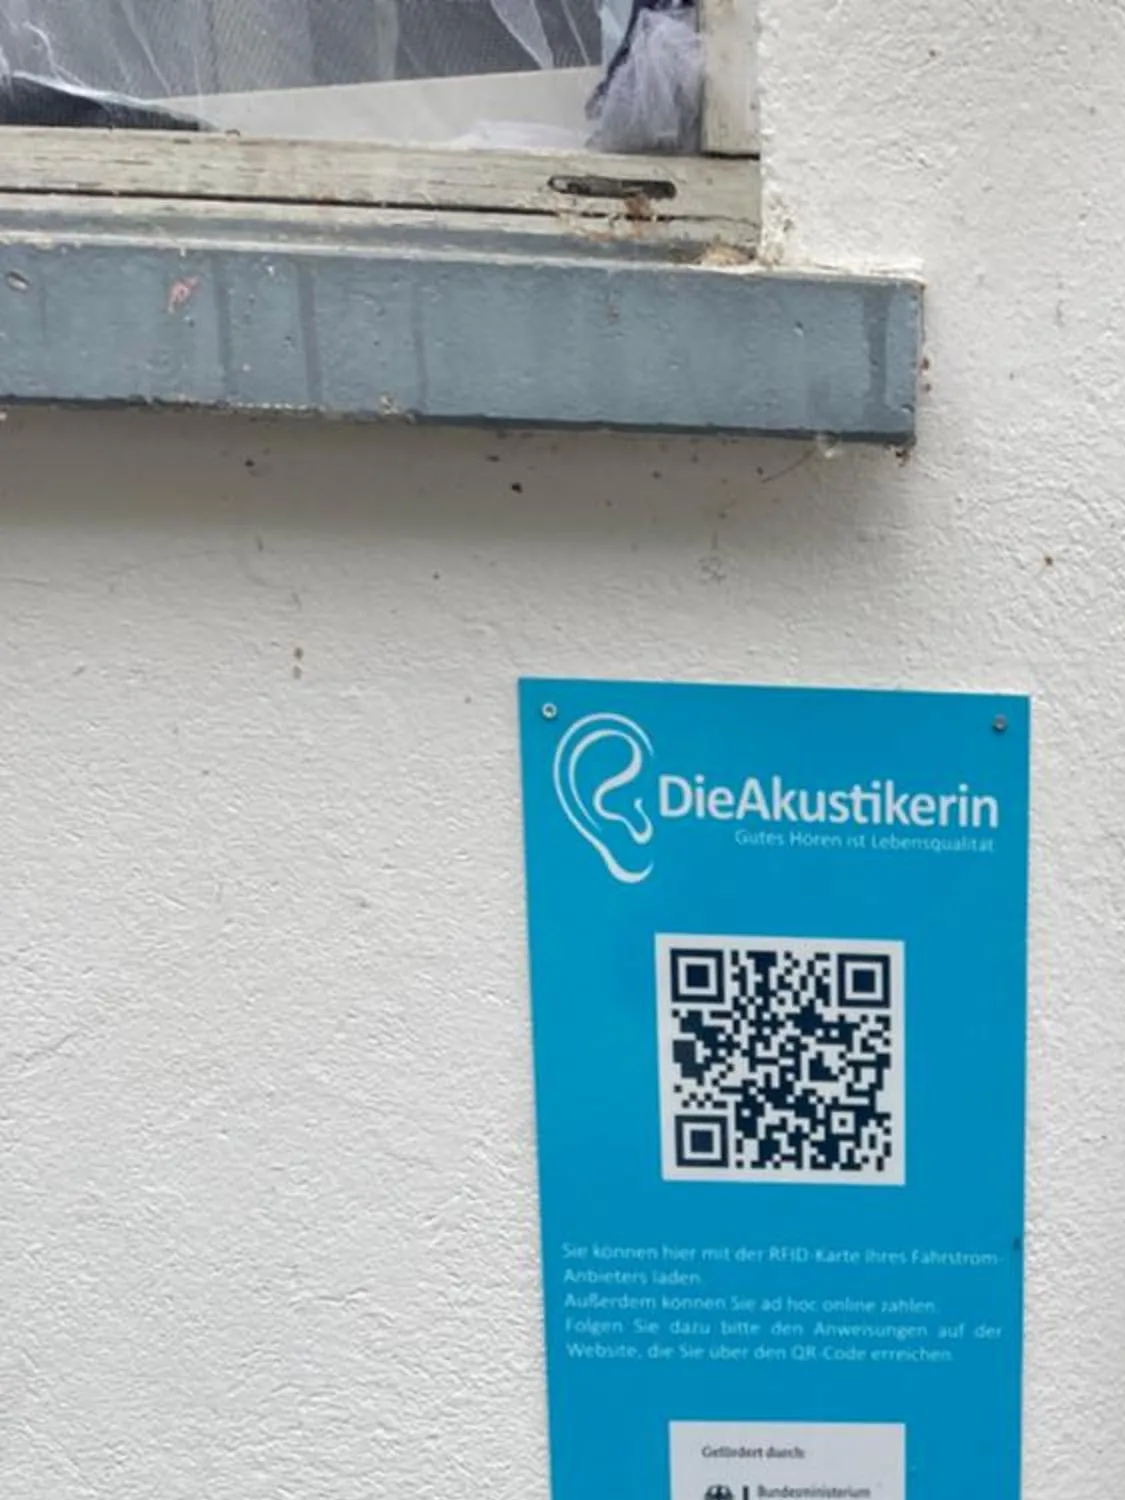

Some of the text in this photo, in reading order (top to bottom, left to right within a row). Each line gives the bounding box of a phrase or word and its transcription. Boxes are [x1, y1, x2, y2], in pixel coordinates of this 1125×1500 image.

[659, 774, 998, 828] DieAkustikerin
[734, 829, 994, 853] Gutes Hören ist Lebensqualität
[562, 1243, 588, 1259] Sie
[592, 1243, 658, 1260] können
[662, 1245, 696, 1260] hier
[702, 1247, 730, 1261] mit
[735, 1248, 763, 1261] der
[865, 1249, 907, 1265] Ihres
[563, 1269, 647, 1285] Anbieters
[564, 1293, 656, 1308] Außerdem
[661, 1295, 726, 1309] können
[731, 1296, 756, 1310] Sie
[761, 1297, 782, 1311] ad
[787, 1297, 816, 1312] hoc
[822, 1298, 876, 1313] online
[565, 1317, 1002, 1340] Folgen Sie dazu bitte den Anweisungen auf der
[647, 1344, 674, 1358] die
[679, 1346, 705, 1359] Sie
[710, 1346, 748, 1360] über
[754, 1345, 786, 1359] den
[702, 1446, 763, 1458] Gefördert
[758, 1486, 870, 1498] Bundesministerium
